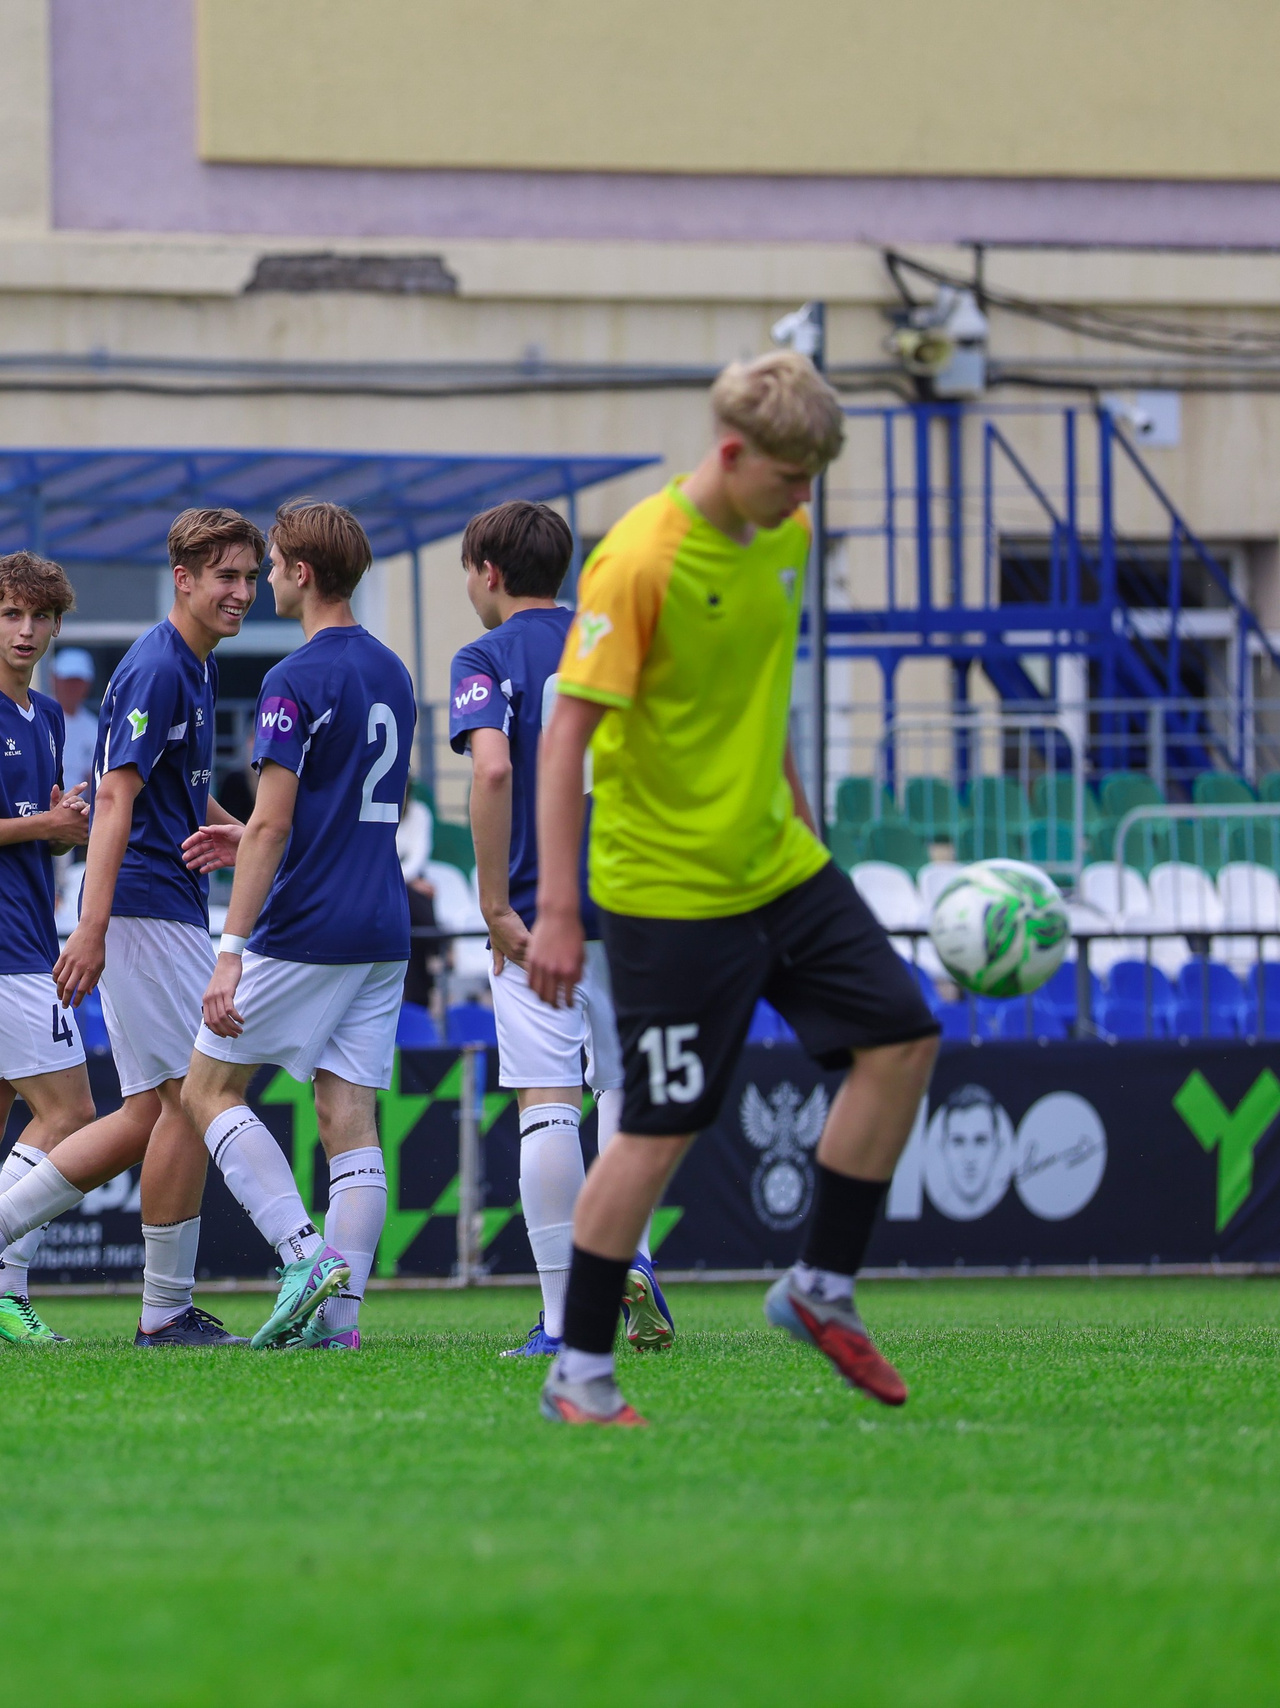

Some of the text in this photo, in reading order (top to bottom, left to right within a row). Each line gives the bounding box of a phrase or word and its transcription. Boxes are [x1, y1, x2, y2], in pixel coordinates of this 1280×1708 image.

[455, 682, 487, 709] wb
[261, 707, 294, 732] wb
[358, 702, 399, 823] 2
[52, 1003, 73, 1048] 4
[637, 1022, 705, 1105] 15
[237, 1117, 261, 1127] KEL
[551, 1118, 579, 1127] KEL
[357, 1167, 386, 1176] KEL
